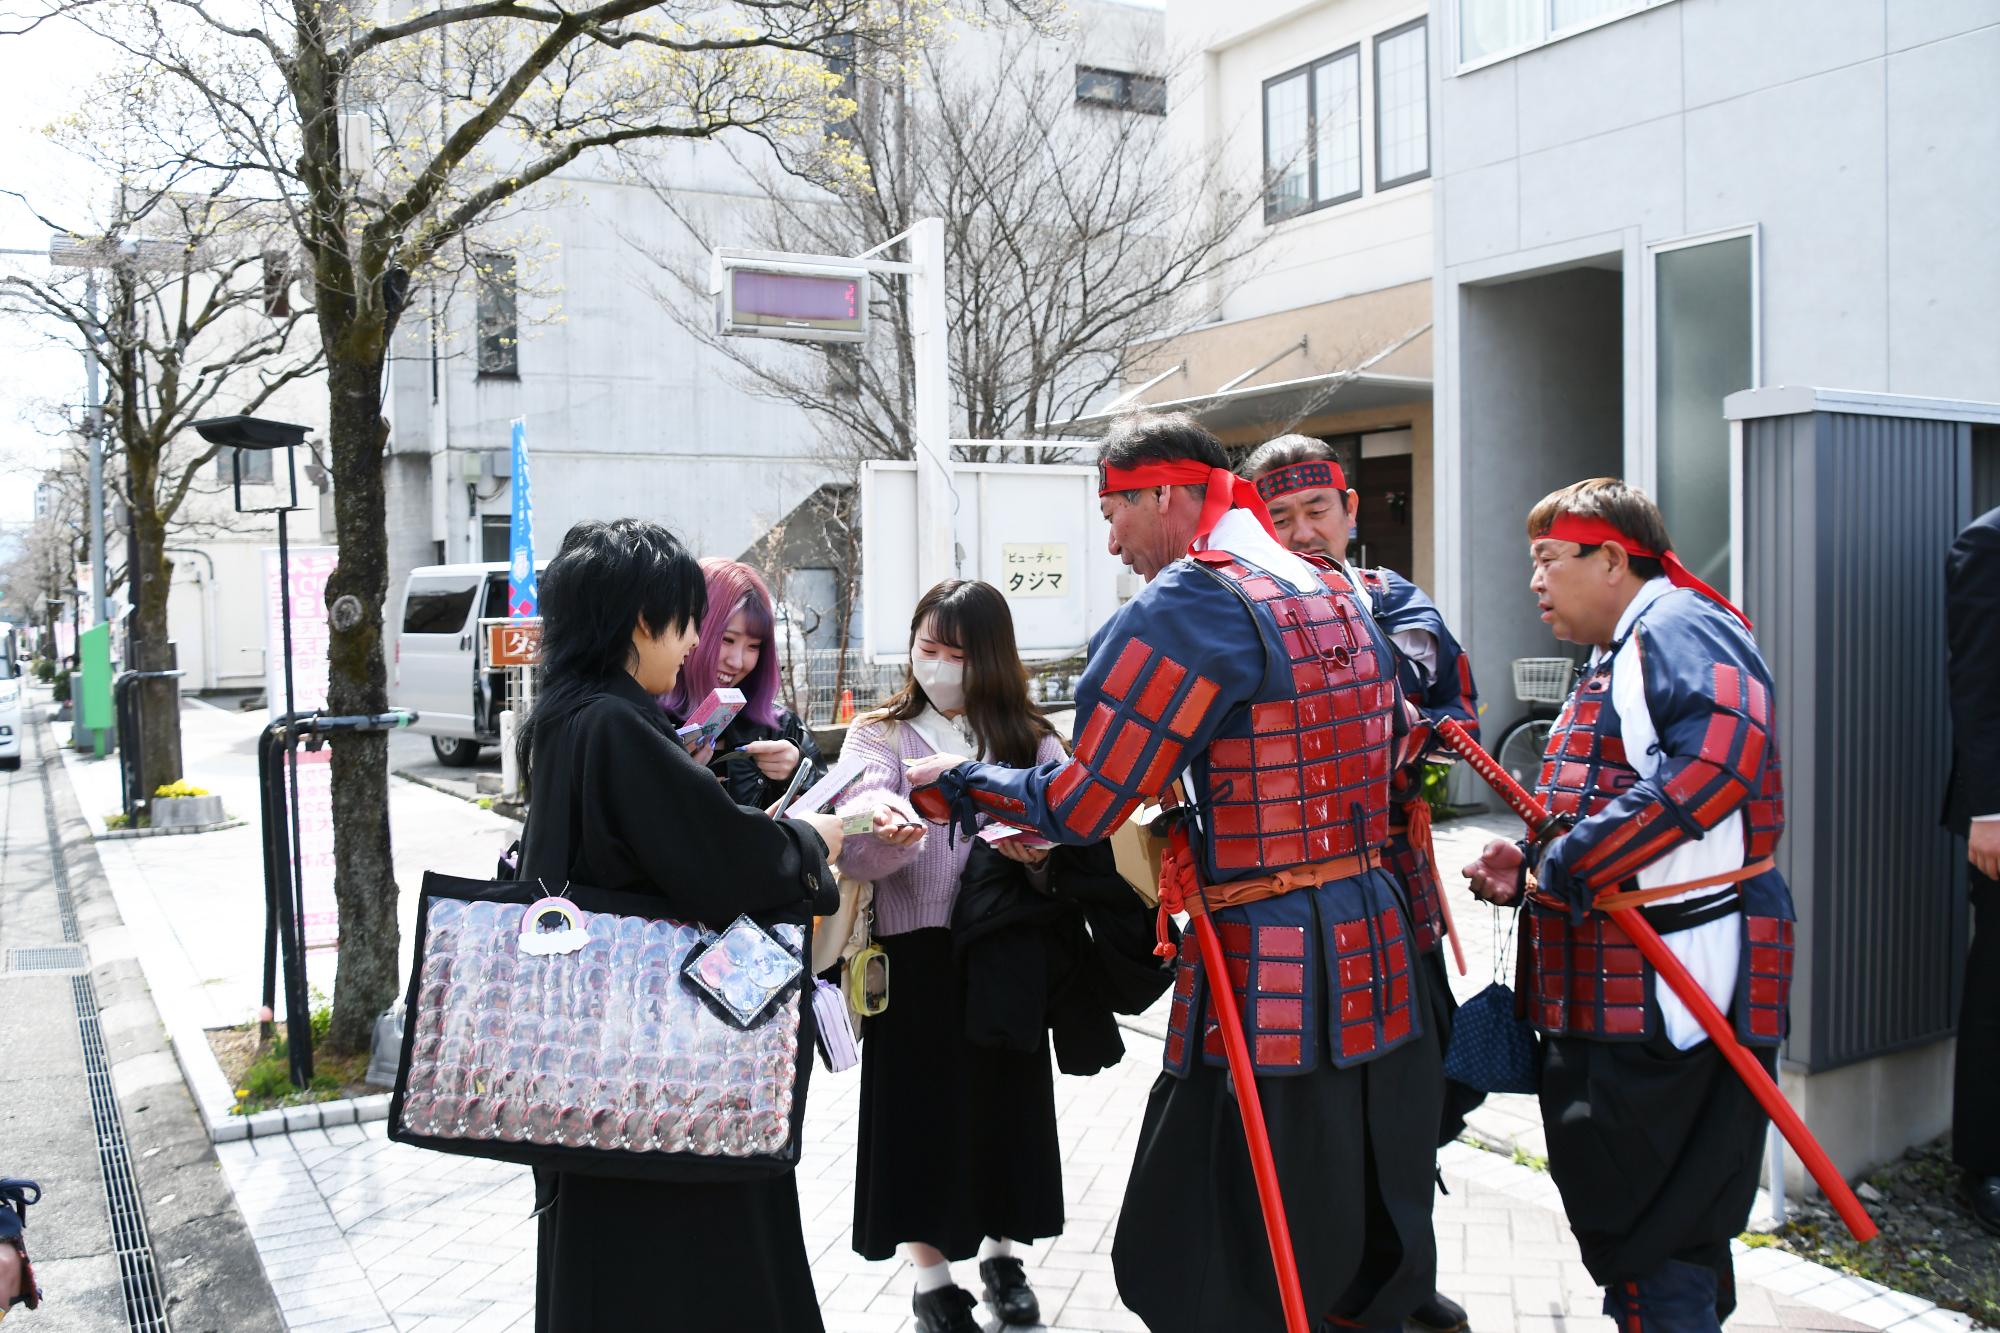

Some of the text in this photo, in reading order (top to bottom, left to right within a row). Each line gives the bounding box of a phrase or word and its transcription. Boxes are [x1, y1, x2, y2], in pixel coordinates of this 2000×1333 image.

[1008, 552, 1063, 563] ビューティー
[1009, 571, 1062, 592] タジマ
